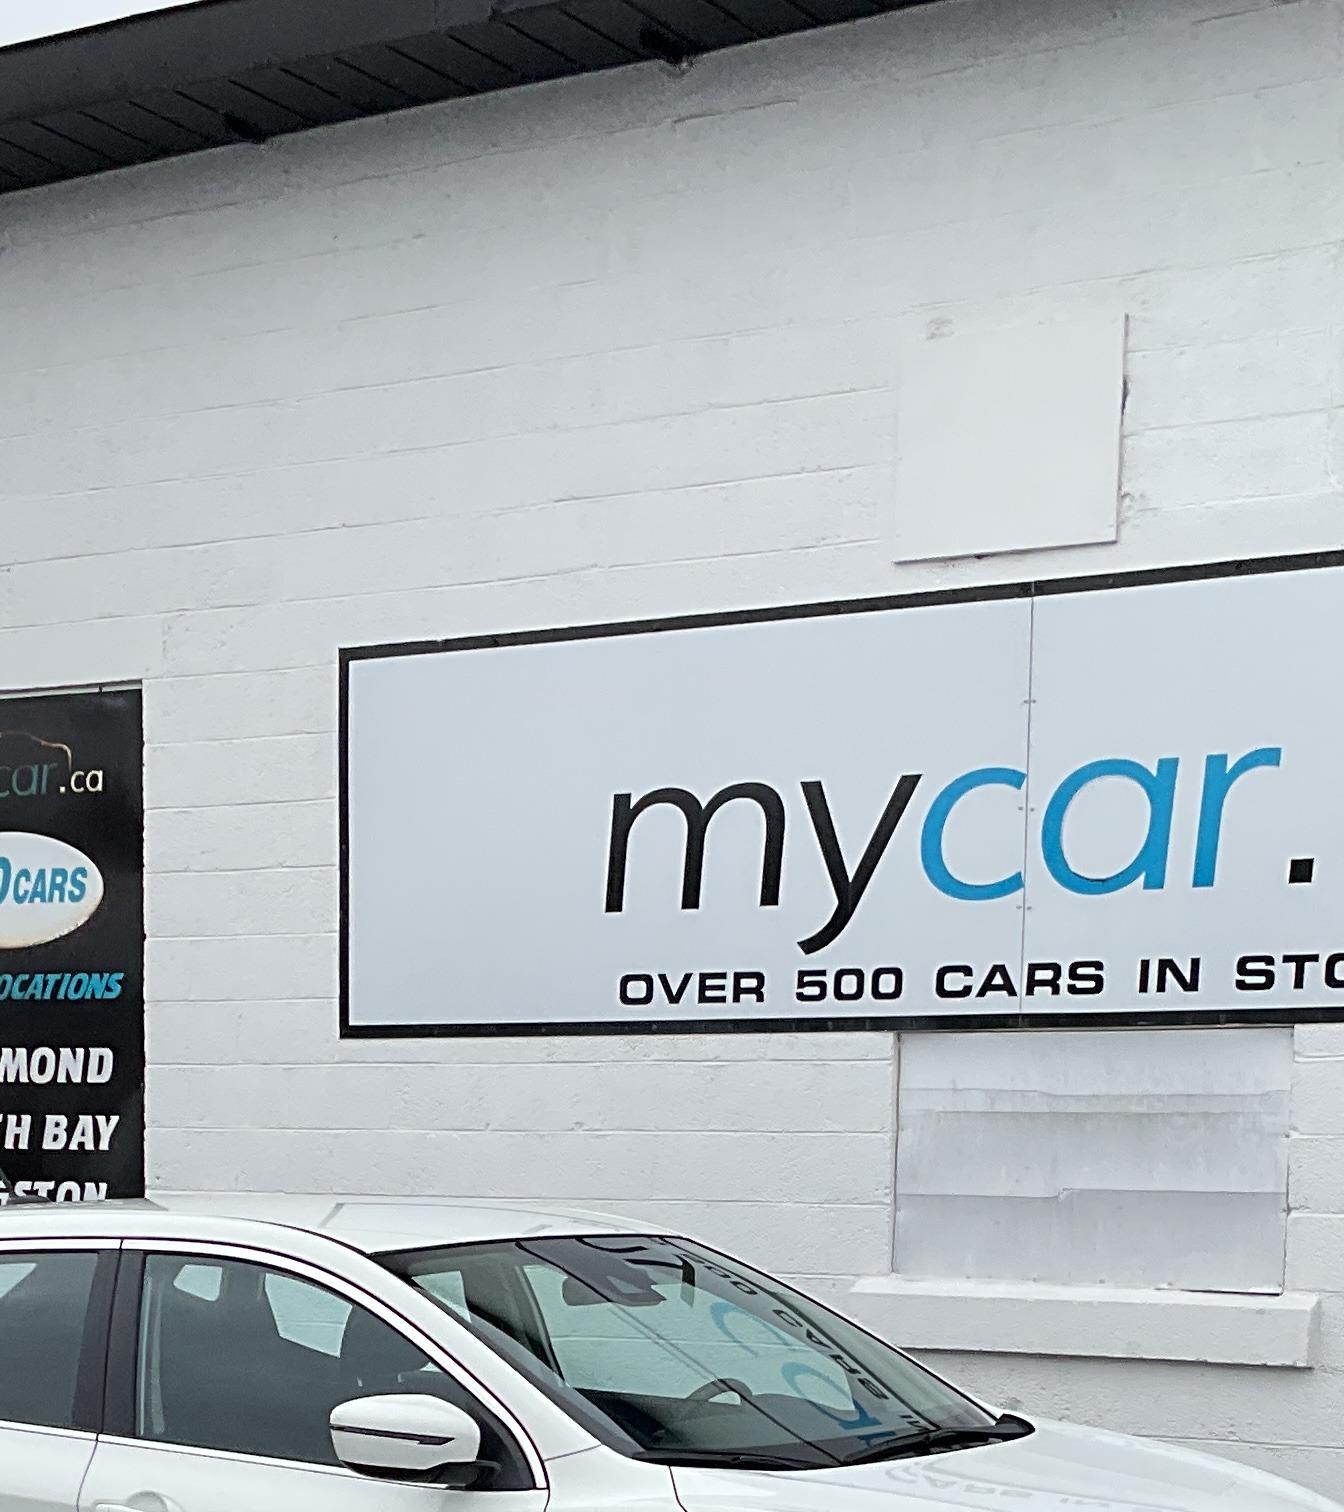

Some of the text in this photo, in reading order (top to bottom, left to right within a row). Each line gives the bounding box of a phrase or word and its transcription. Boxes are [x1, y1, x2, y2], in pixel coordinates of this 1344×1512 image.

[620, 971, 766, 1005] OVER
[796, 967, 903, 1002] 500
[935, 960, 1104, 999] CARS
[1138, 957, 1201, 993] IN
[42, 1114, 119, 1151] BAY
